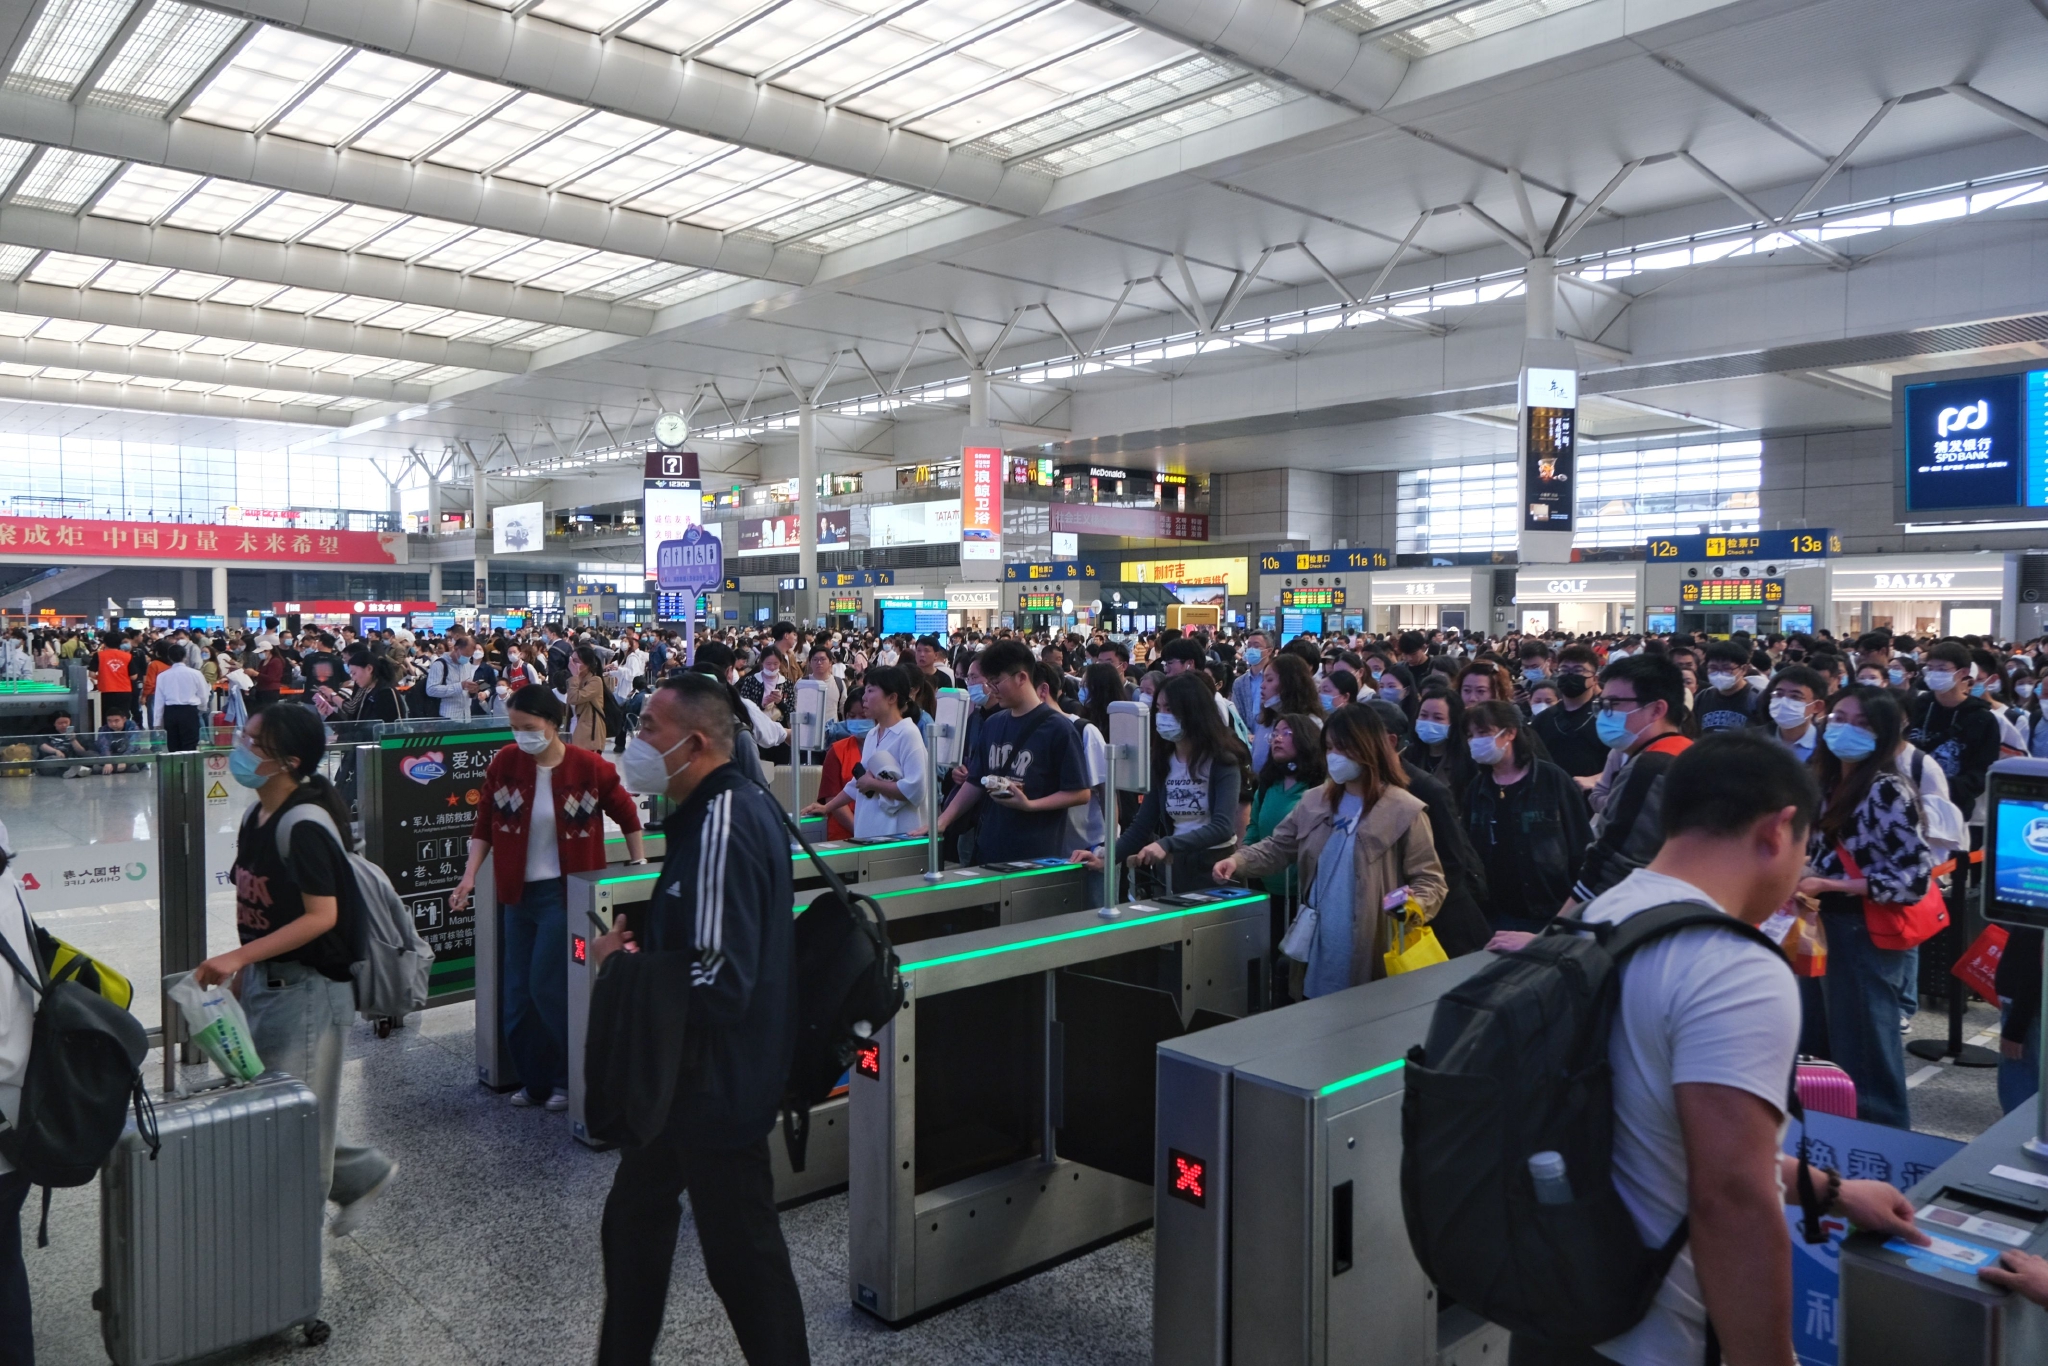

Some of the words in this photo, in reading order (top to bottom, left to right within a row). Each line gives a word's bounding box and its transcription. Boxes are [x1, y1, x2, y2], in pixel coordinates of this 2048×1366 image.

[1934, 438, 1992, 453] 浦发银行
[1935, 453, 1957, 463] SPD
[1957, 451, 1989, 461] BANK
[1090, 467, 1126, 479] McDonald's
[974, 470, 990, 525] 浪鲸卫浴
[103, 526, 218, 551] 中国力量
[235, 531, 339, 555] 未来希望
[1727, 538, 1760, 548] 检票口
[1791, 535, 1822, 552] 13B
[1829, 535, 1842, 552] 13B
[1650, 541, 1678, 557] 12B
[1262, 557, 1280, 570] 10B
[1309, 555, 1331, 563] 检票口
[1348, 553, 1368, 567] 11B
[1372, 553, 1387, 567] 11B
[726, 580, 735, 589] 5B
[1547, 580, 1588, 593] GOLF
[1874, 573, 1955, 588] BALLY
[1683, 585, 1698, 593] 12B
[1765, 583, 1781, 592] 13B
[952, 593, 991, 602] COACH
[453, 771, 470, 780] Kind
[415, 880, 428, 888] Easy
[428, 877, 446, 885] Access
